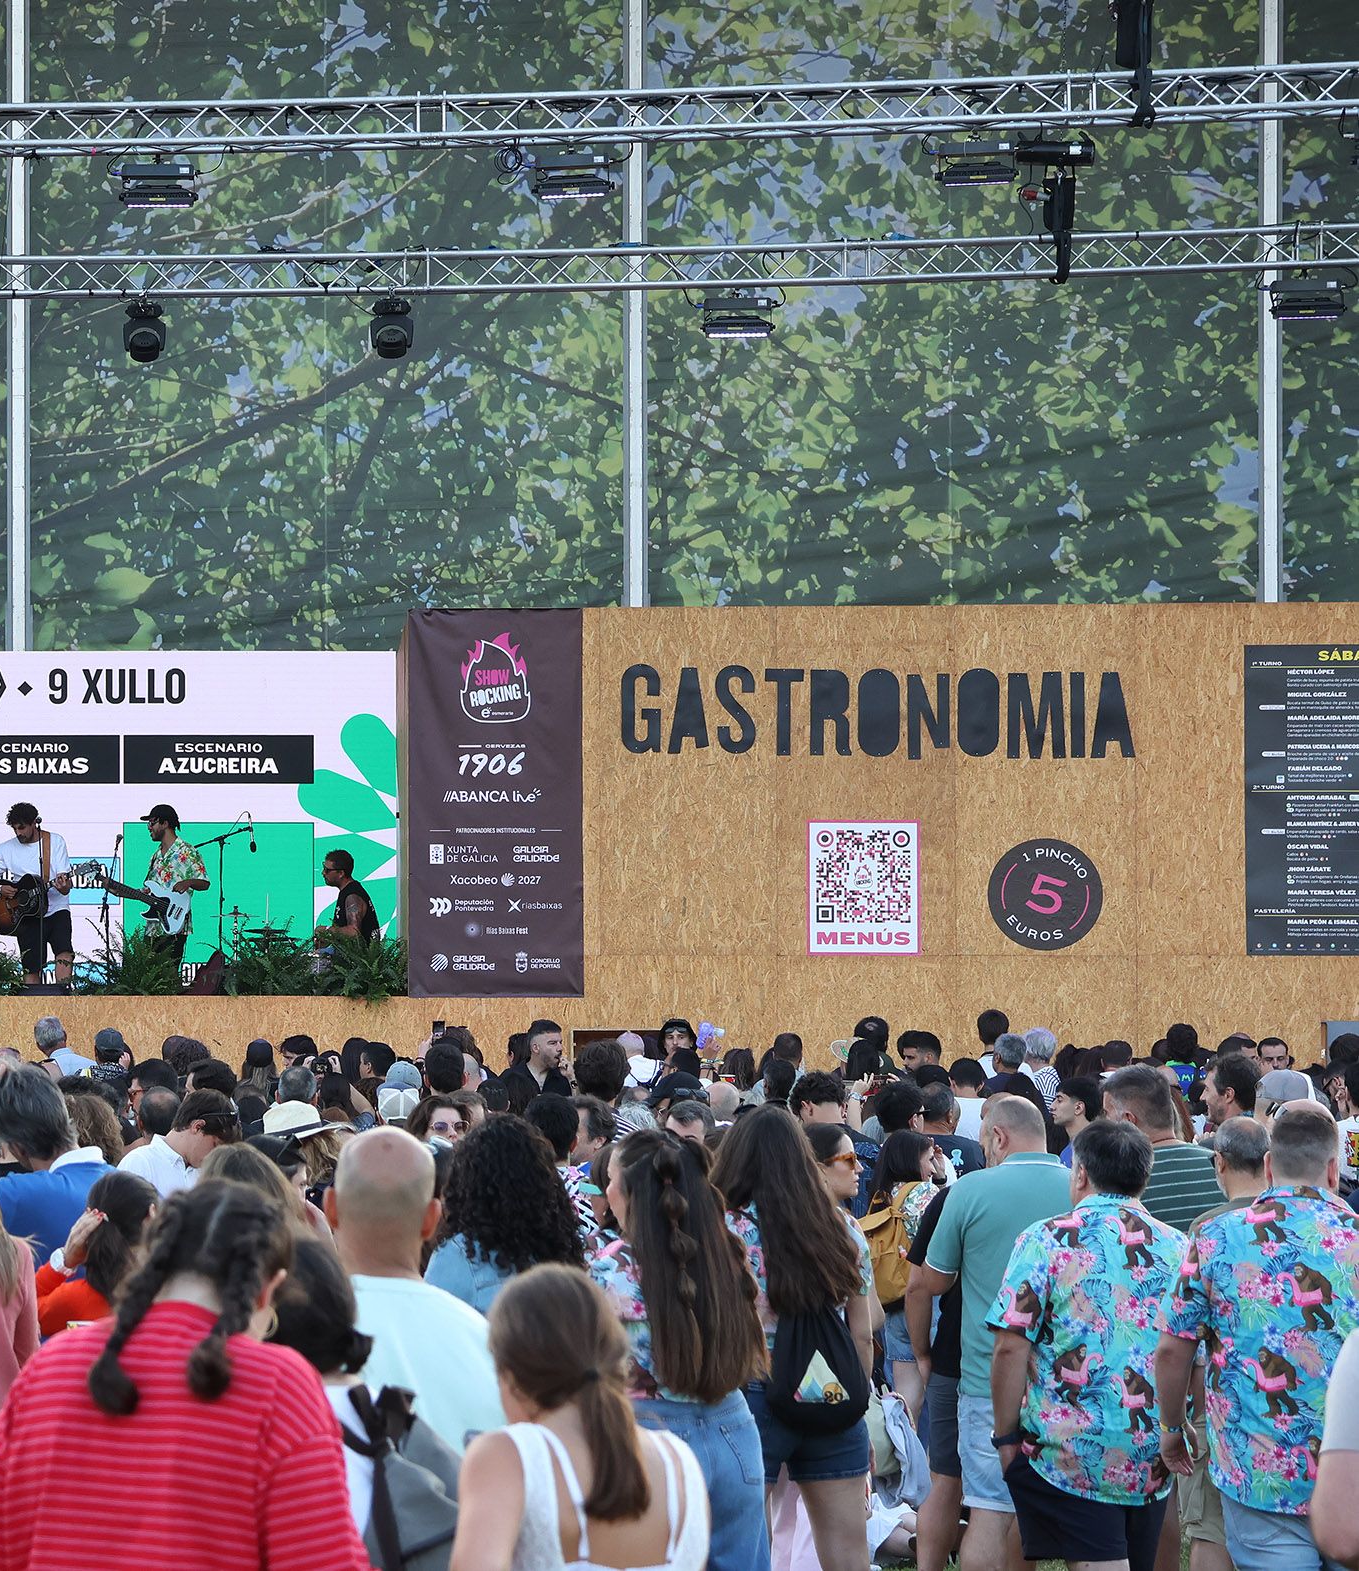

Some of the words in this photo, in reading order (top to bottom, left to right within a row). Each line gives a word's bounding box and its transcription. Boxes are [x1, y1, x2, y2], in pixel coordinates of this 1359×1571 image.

[48, 668, 68, 705] 9
[82, 668, 186, 705] XULLO
[474, 669, 510, 686] SHOW
[469, 683, 522, 707] ROCKING
[620, 663, 1136, 759] GASTRONOMIA
[174, 743, 263, 753] ESCENARIO
[16, 757, 89, 774] BAIXAS
[157, 757, 279, 774] AZUCREIRA
[458, 751, 526, 777] 1906
[1022, 852, 1031, 862] 1
[1035, 848, 1088, 879] PINCHO
[450, 874, 498, 885] Xacobeo
[518, 875, 541, 885] 2027
[1025, 873, 1068, 915] 5
[516, 926, 528, 934] Fest
[816, 928, 911, 946] MENÚS
[1006, 914, 1064, 941] EUROS
